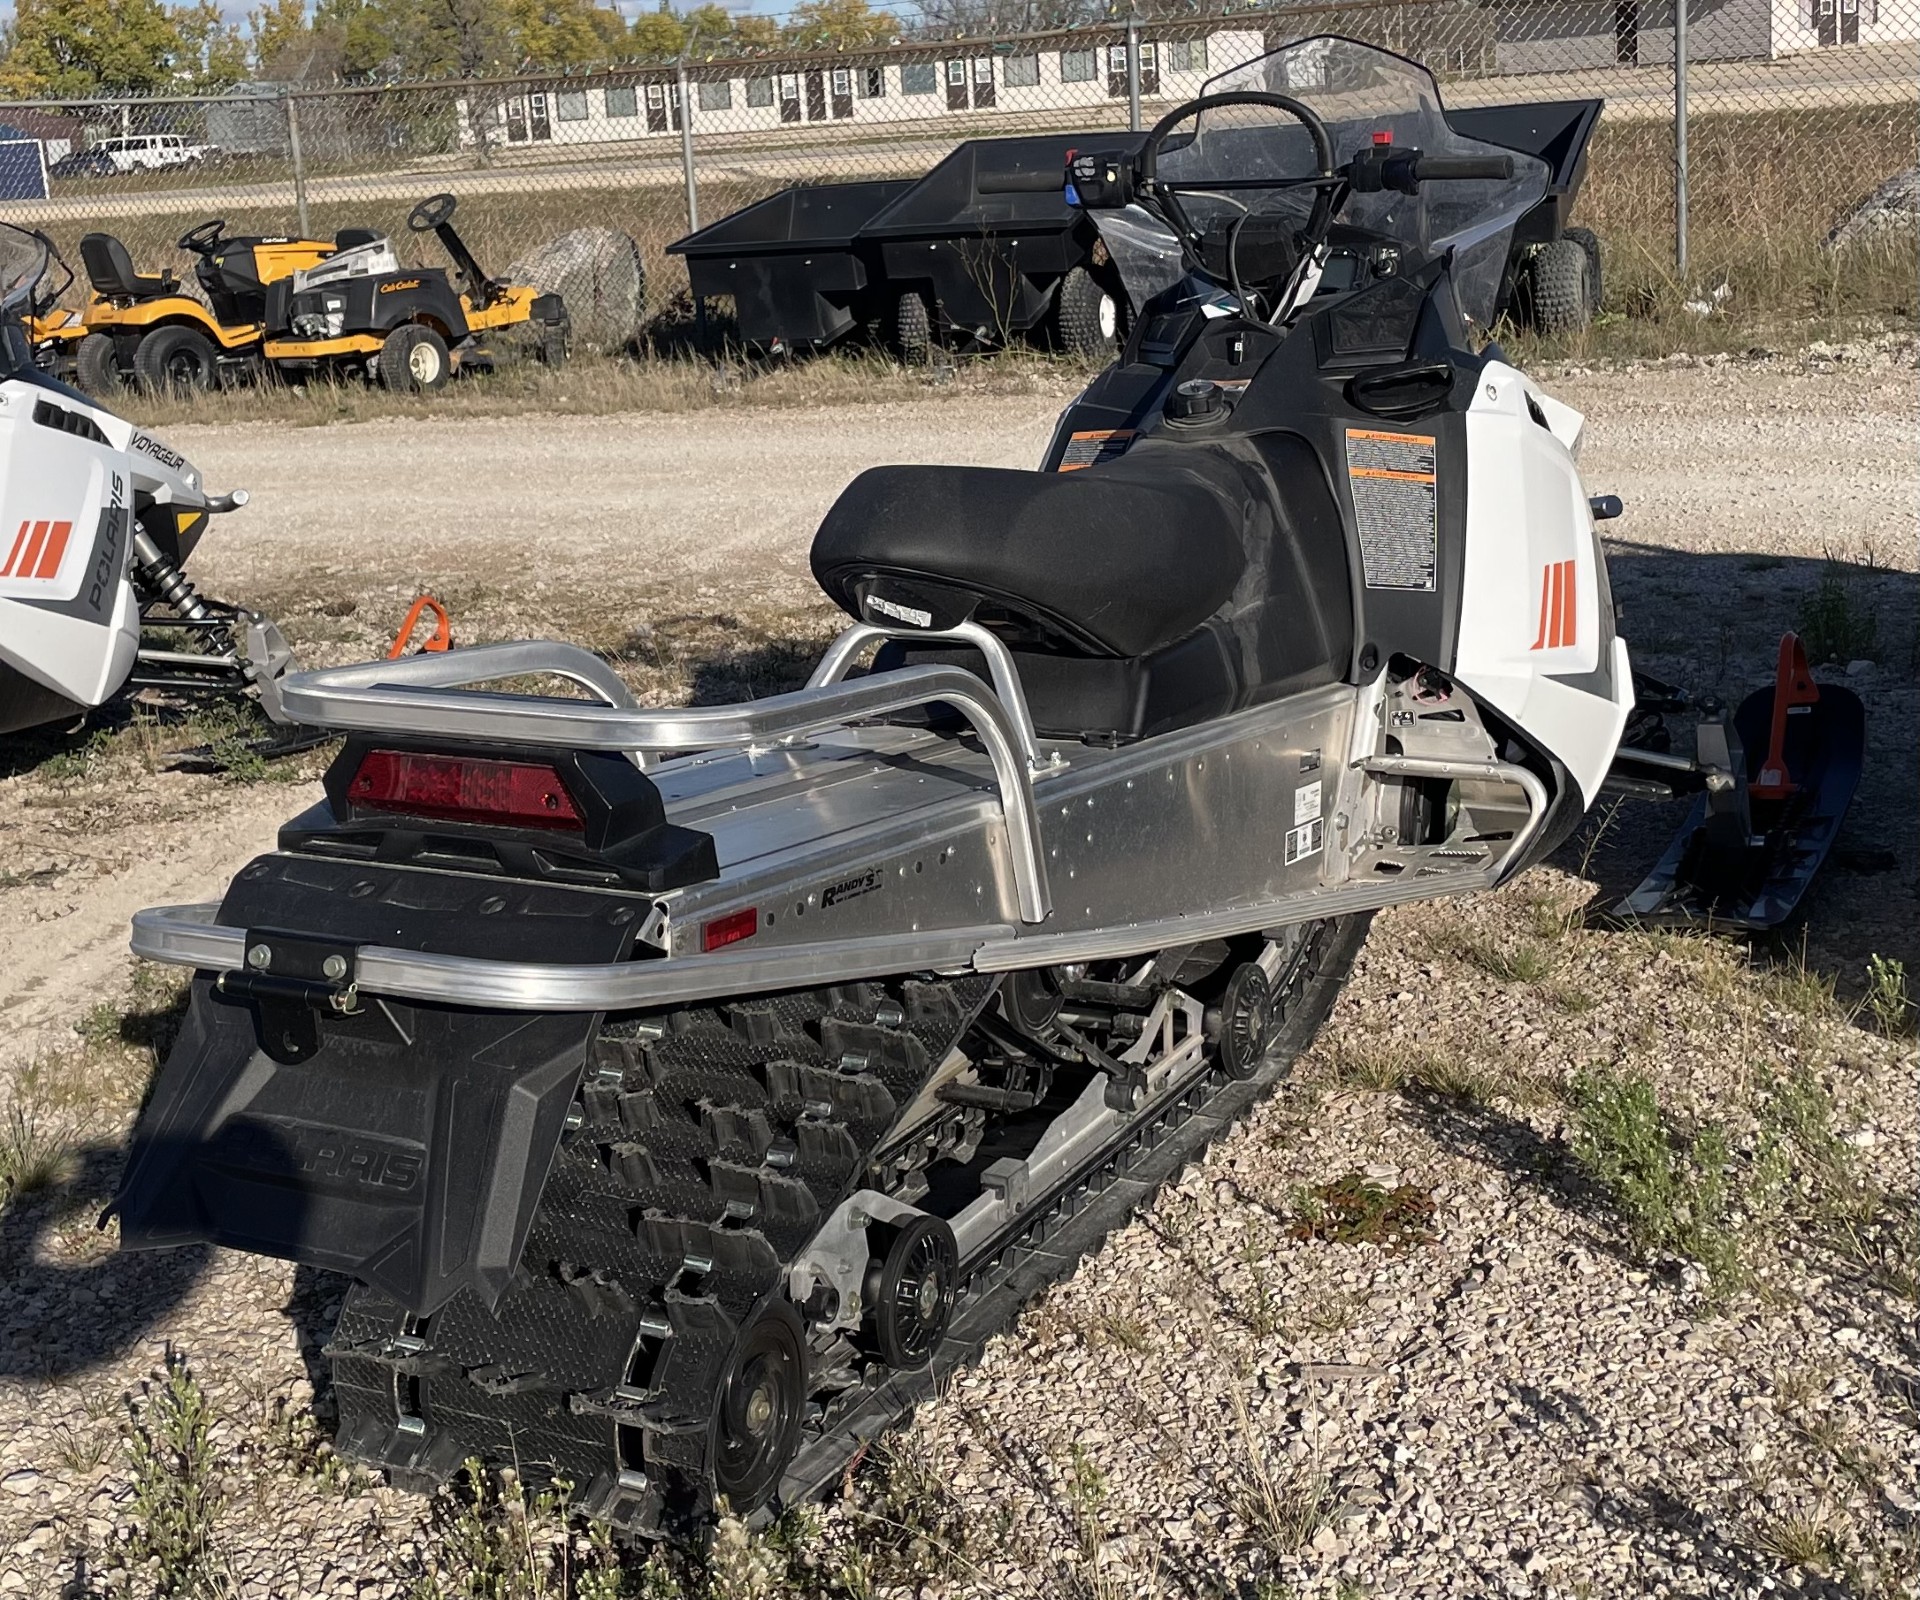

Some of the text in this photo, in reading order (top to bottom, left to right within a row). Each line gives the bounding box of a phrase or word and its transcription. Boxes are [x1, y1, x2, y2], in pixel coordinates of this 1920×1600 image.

[380, 283, 396, 294] Cub
[131, 431, 185, 472] VOYAGEUR
[88, 470, 124, 612] POLARIS
